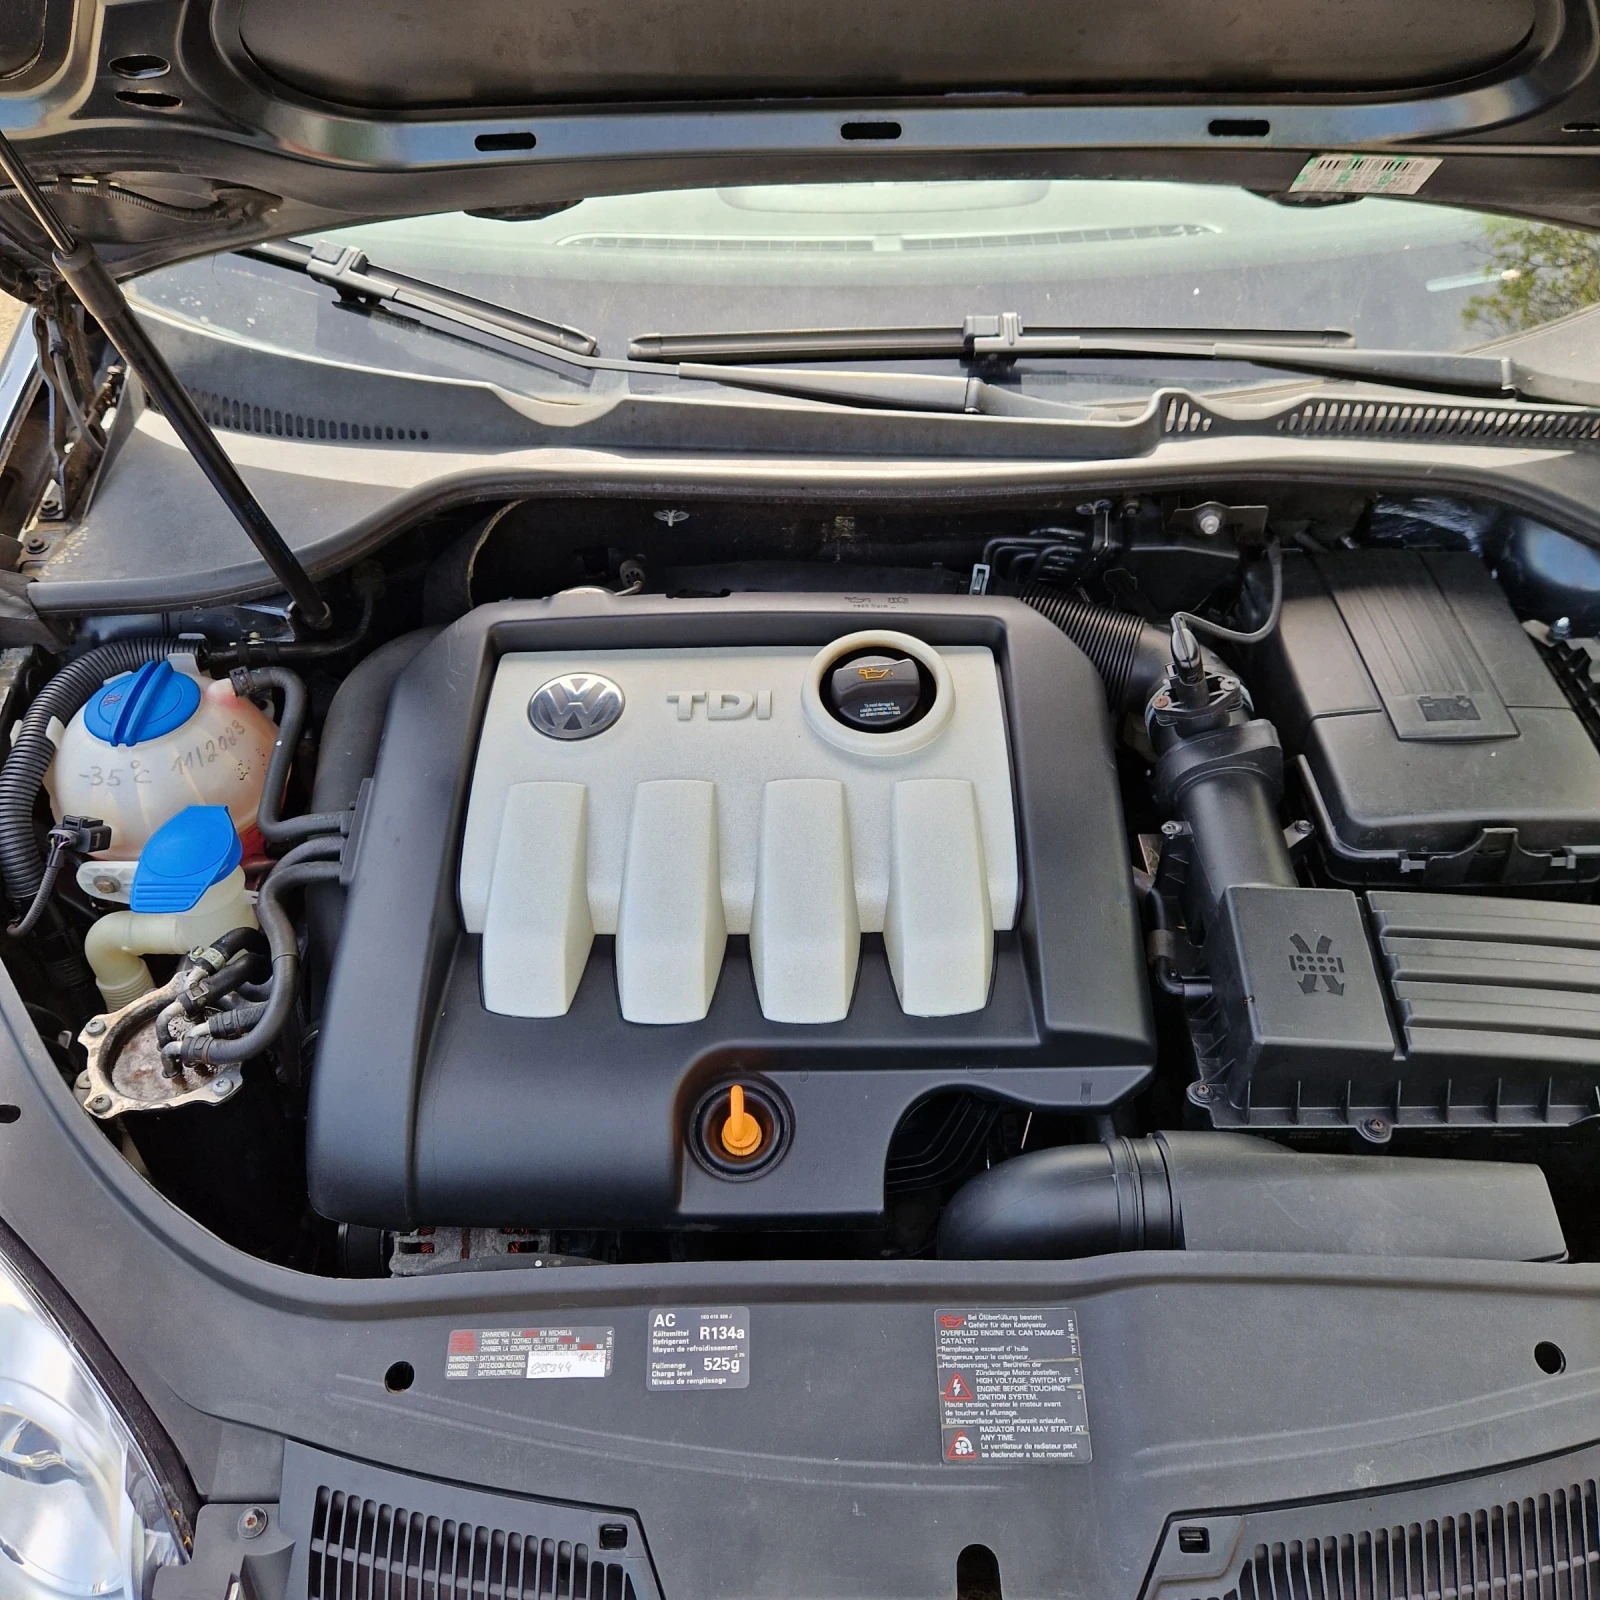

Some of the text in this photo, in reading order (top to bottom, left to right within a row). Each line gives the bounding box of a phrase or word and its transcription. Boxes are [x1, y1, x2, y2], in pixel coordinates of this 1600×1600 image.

[666, 690, 772, 720] TDI
[653, 1313, 676, 1327] AC
[700, 1326, 745, 1340] R134a
[652, 1338, 689, 1346] Refrigerant
[652, 1346, 674, 1354] Moyen
[687, 1344, 738, 1352] refroidissement
[652, 1362, 686, 1370] Füllmenge
[703, 1357, 740, 1373] 525g
[687, 1377, 726, 1385] remplissage
